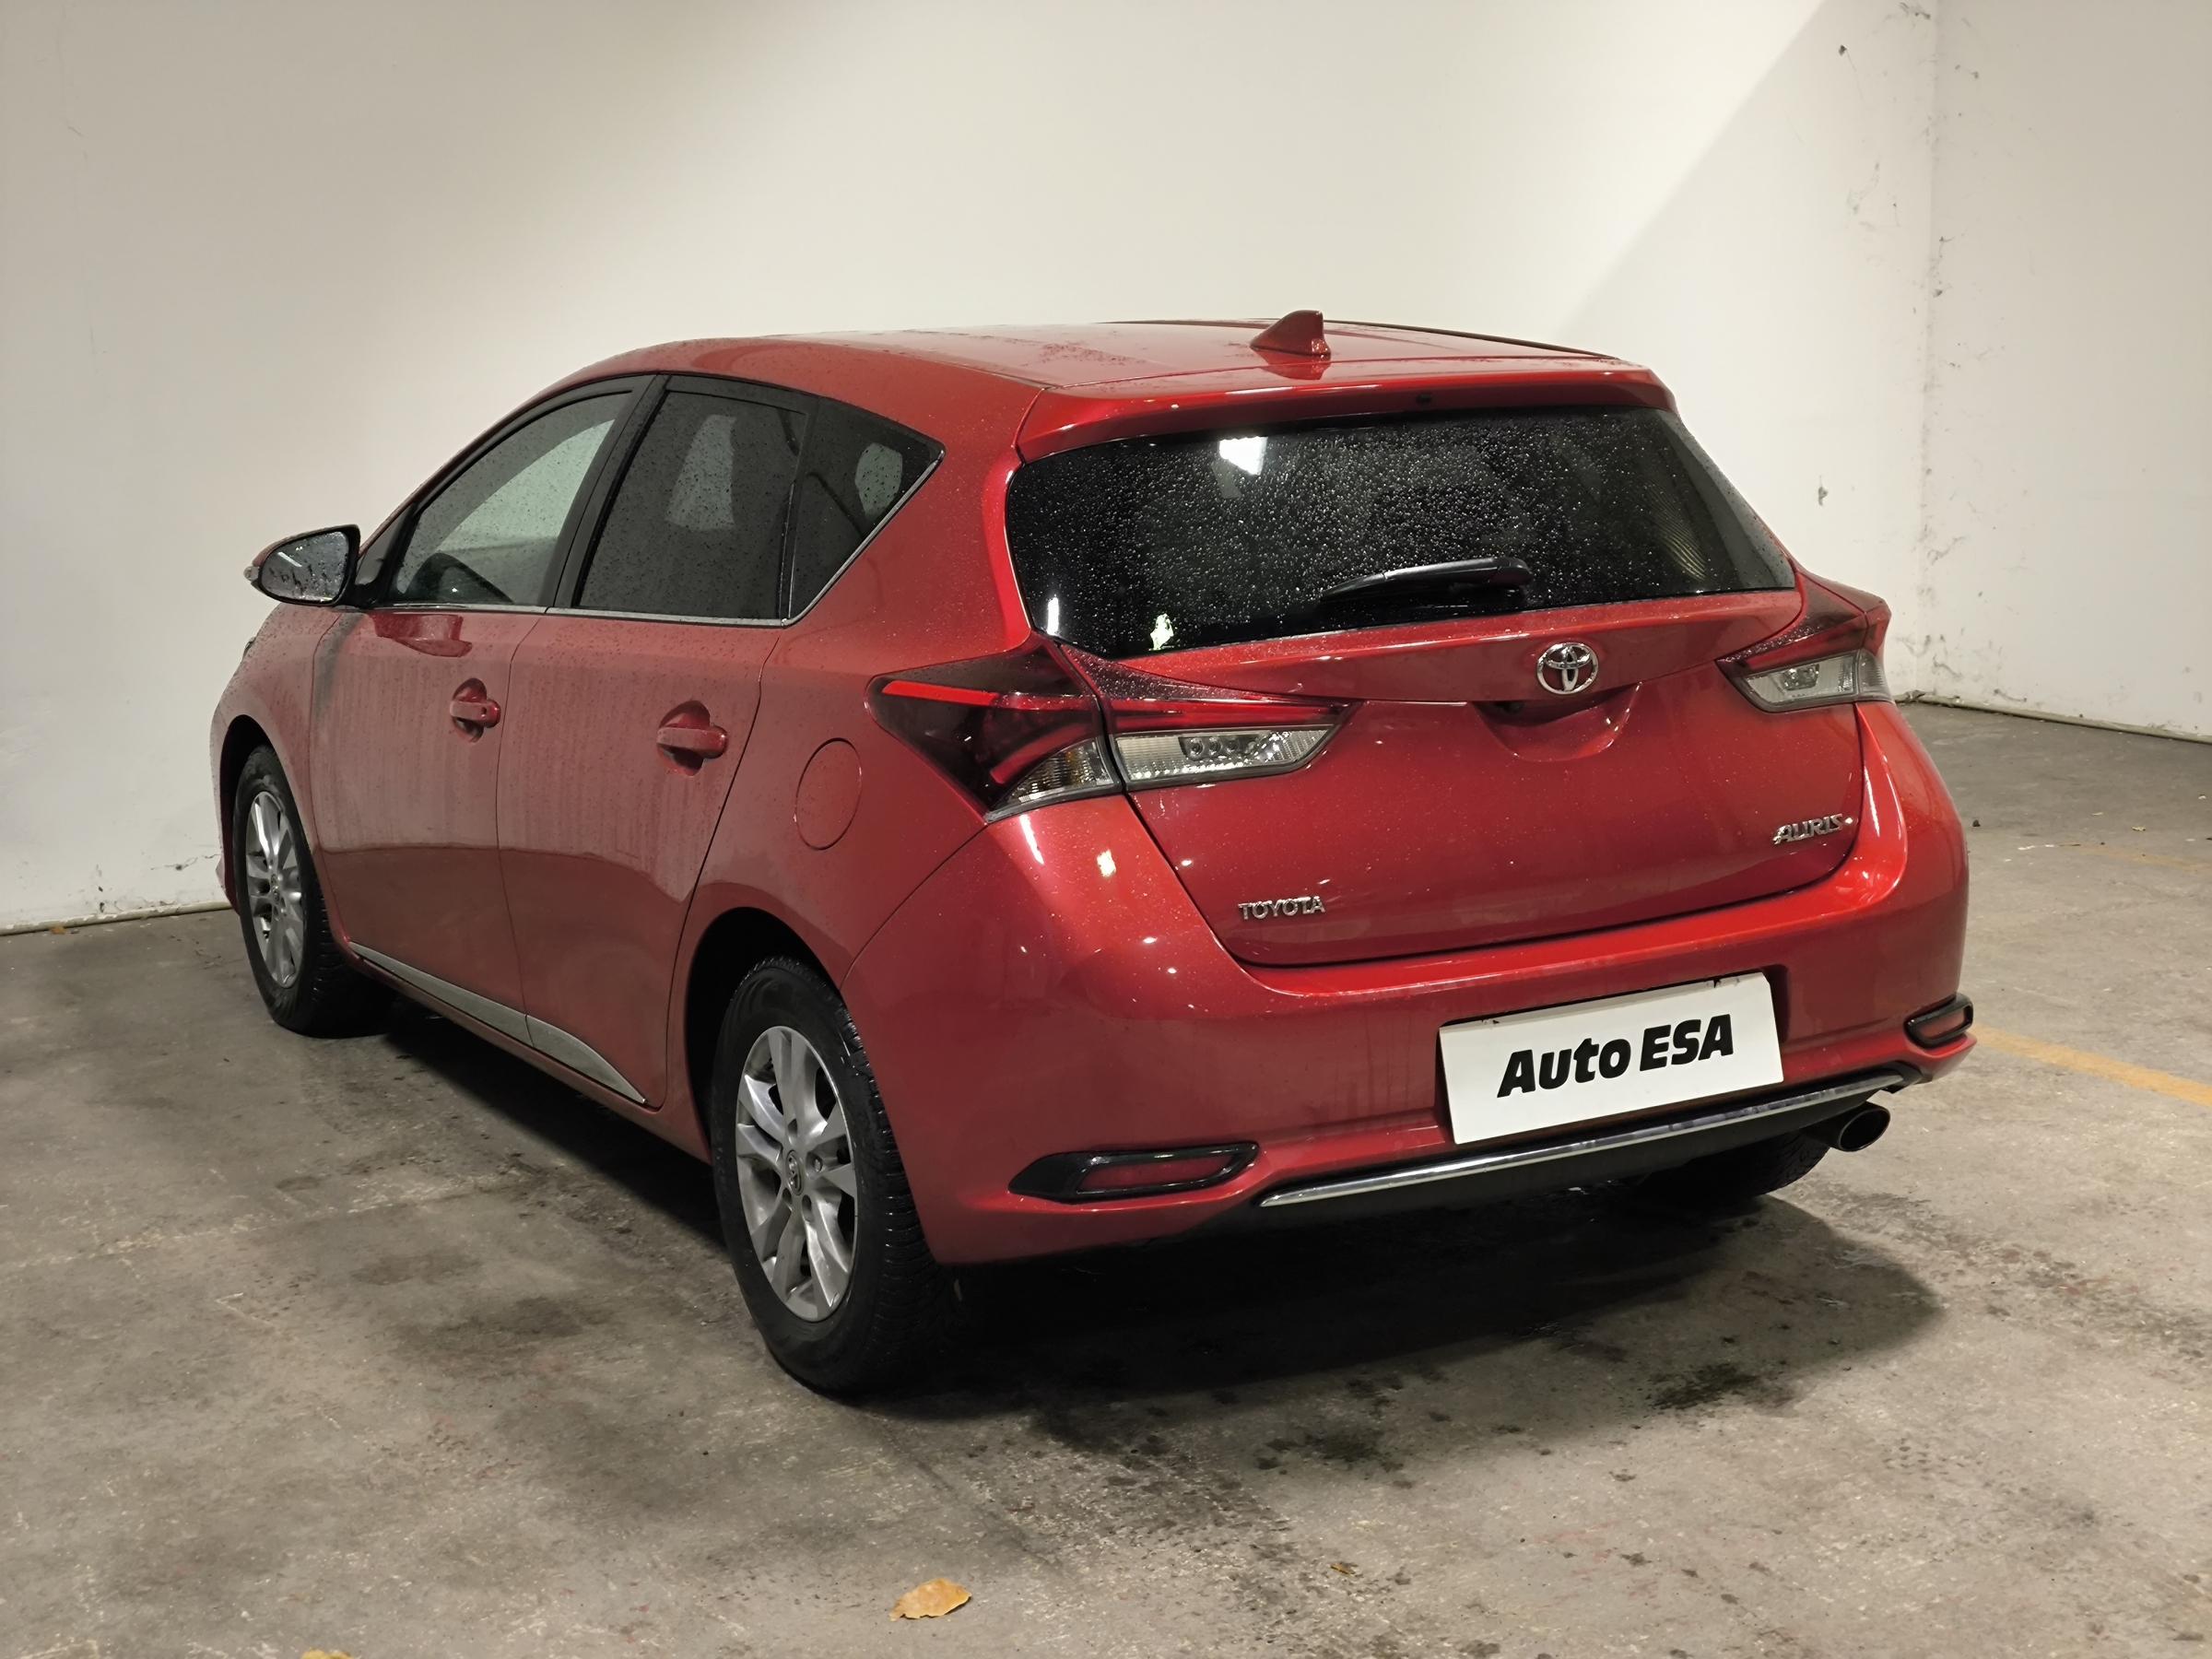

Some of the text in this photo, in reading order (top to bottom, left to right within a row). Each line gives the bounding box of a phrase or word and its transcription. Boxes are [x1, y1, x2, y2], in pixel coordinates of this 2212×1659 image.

[1772, 813, 1843, 845] AURIS
[1238, 895, 1326, 920] TOYOTA
[1497, 1014, 1734, 1098] Auto ESA
